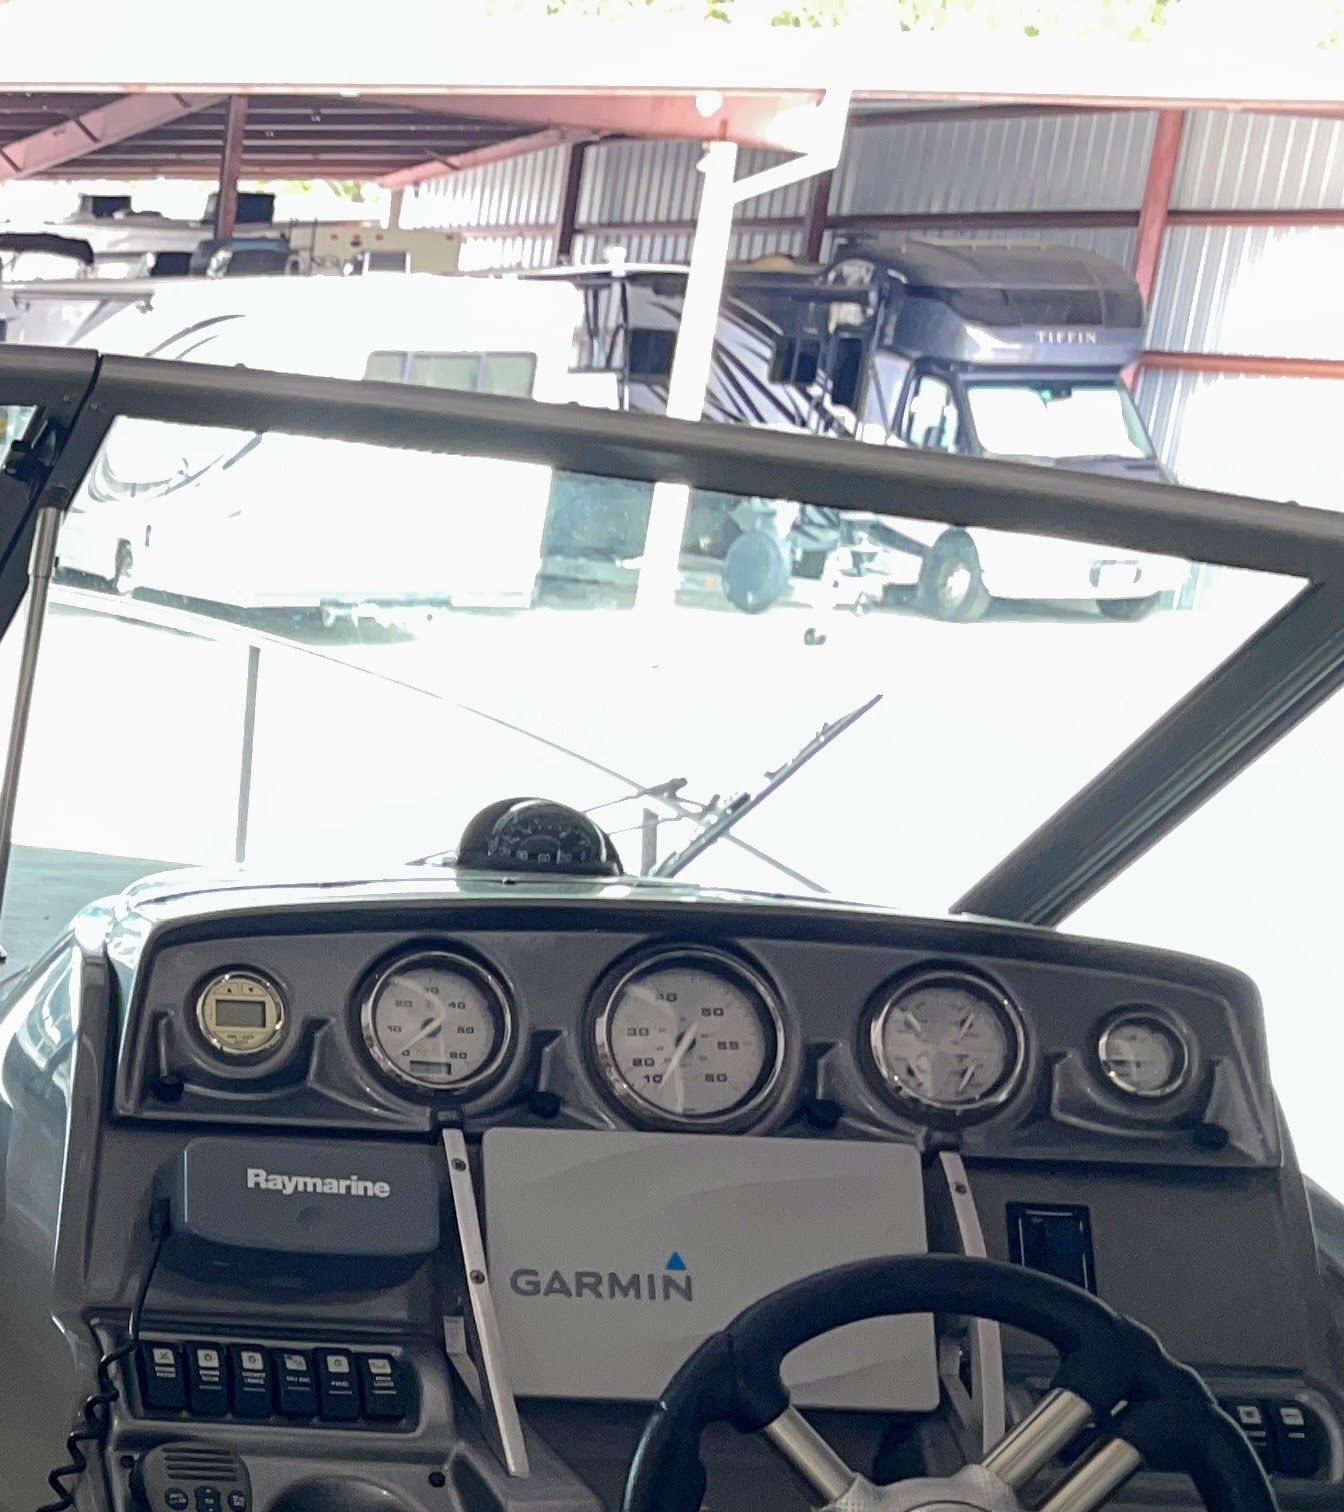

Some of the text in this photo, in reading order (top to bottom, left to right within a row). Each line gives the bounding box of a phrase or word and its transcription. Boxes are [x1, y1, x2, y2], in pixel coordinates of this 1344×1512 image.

[1034, 330, 1097, 344] TIFFIN
[448, 1001, 466, 1010] 40
[387, 1025, 402, 1033] 10
[627, 1027, 649, 1036] 30
[643, 1074, 663, 1084] 10
[247, 1168, 390, 1198] Raymarine
[510, 1269, 692, 1302] GARMIN
